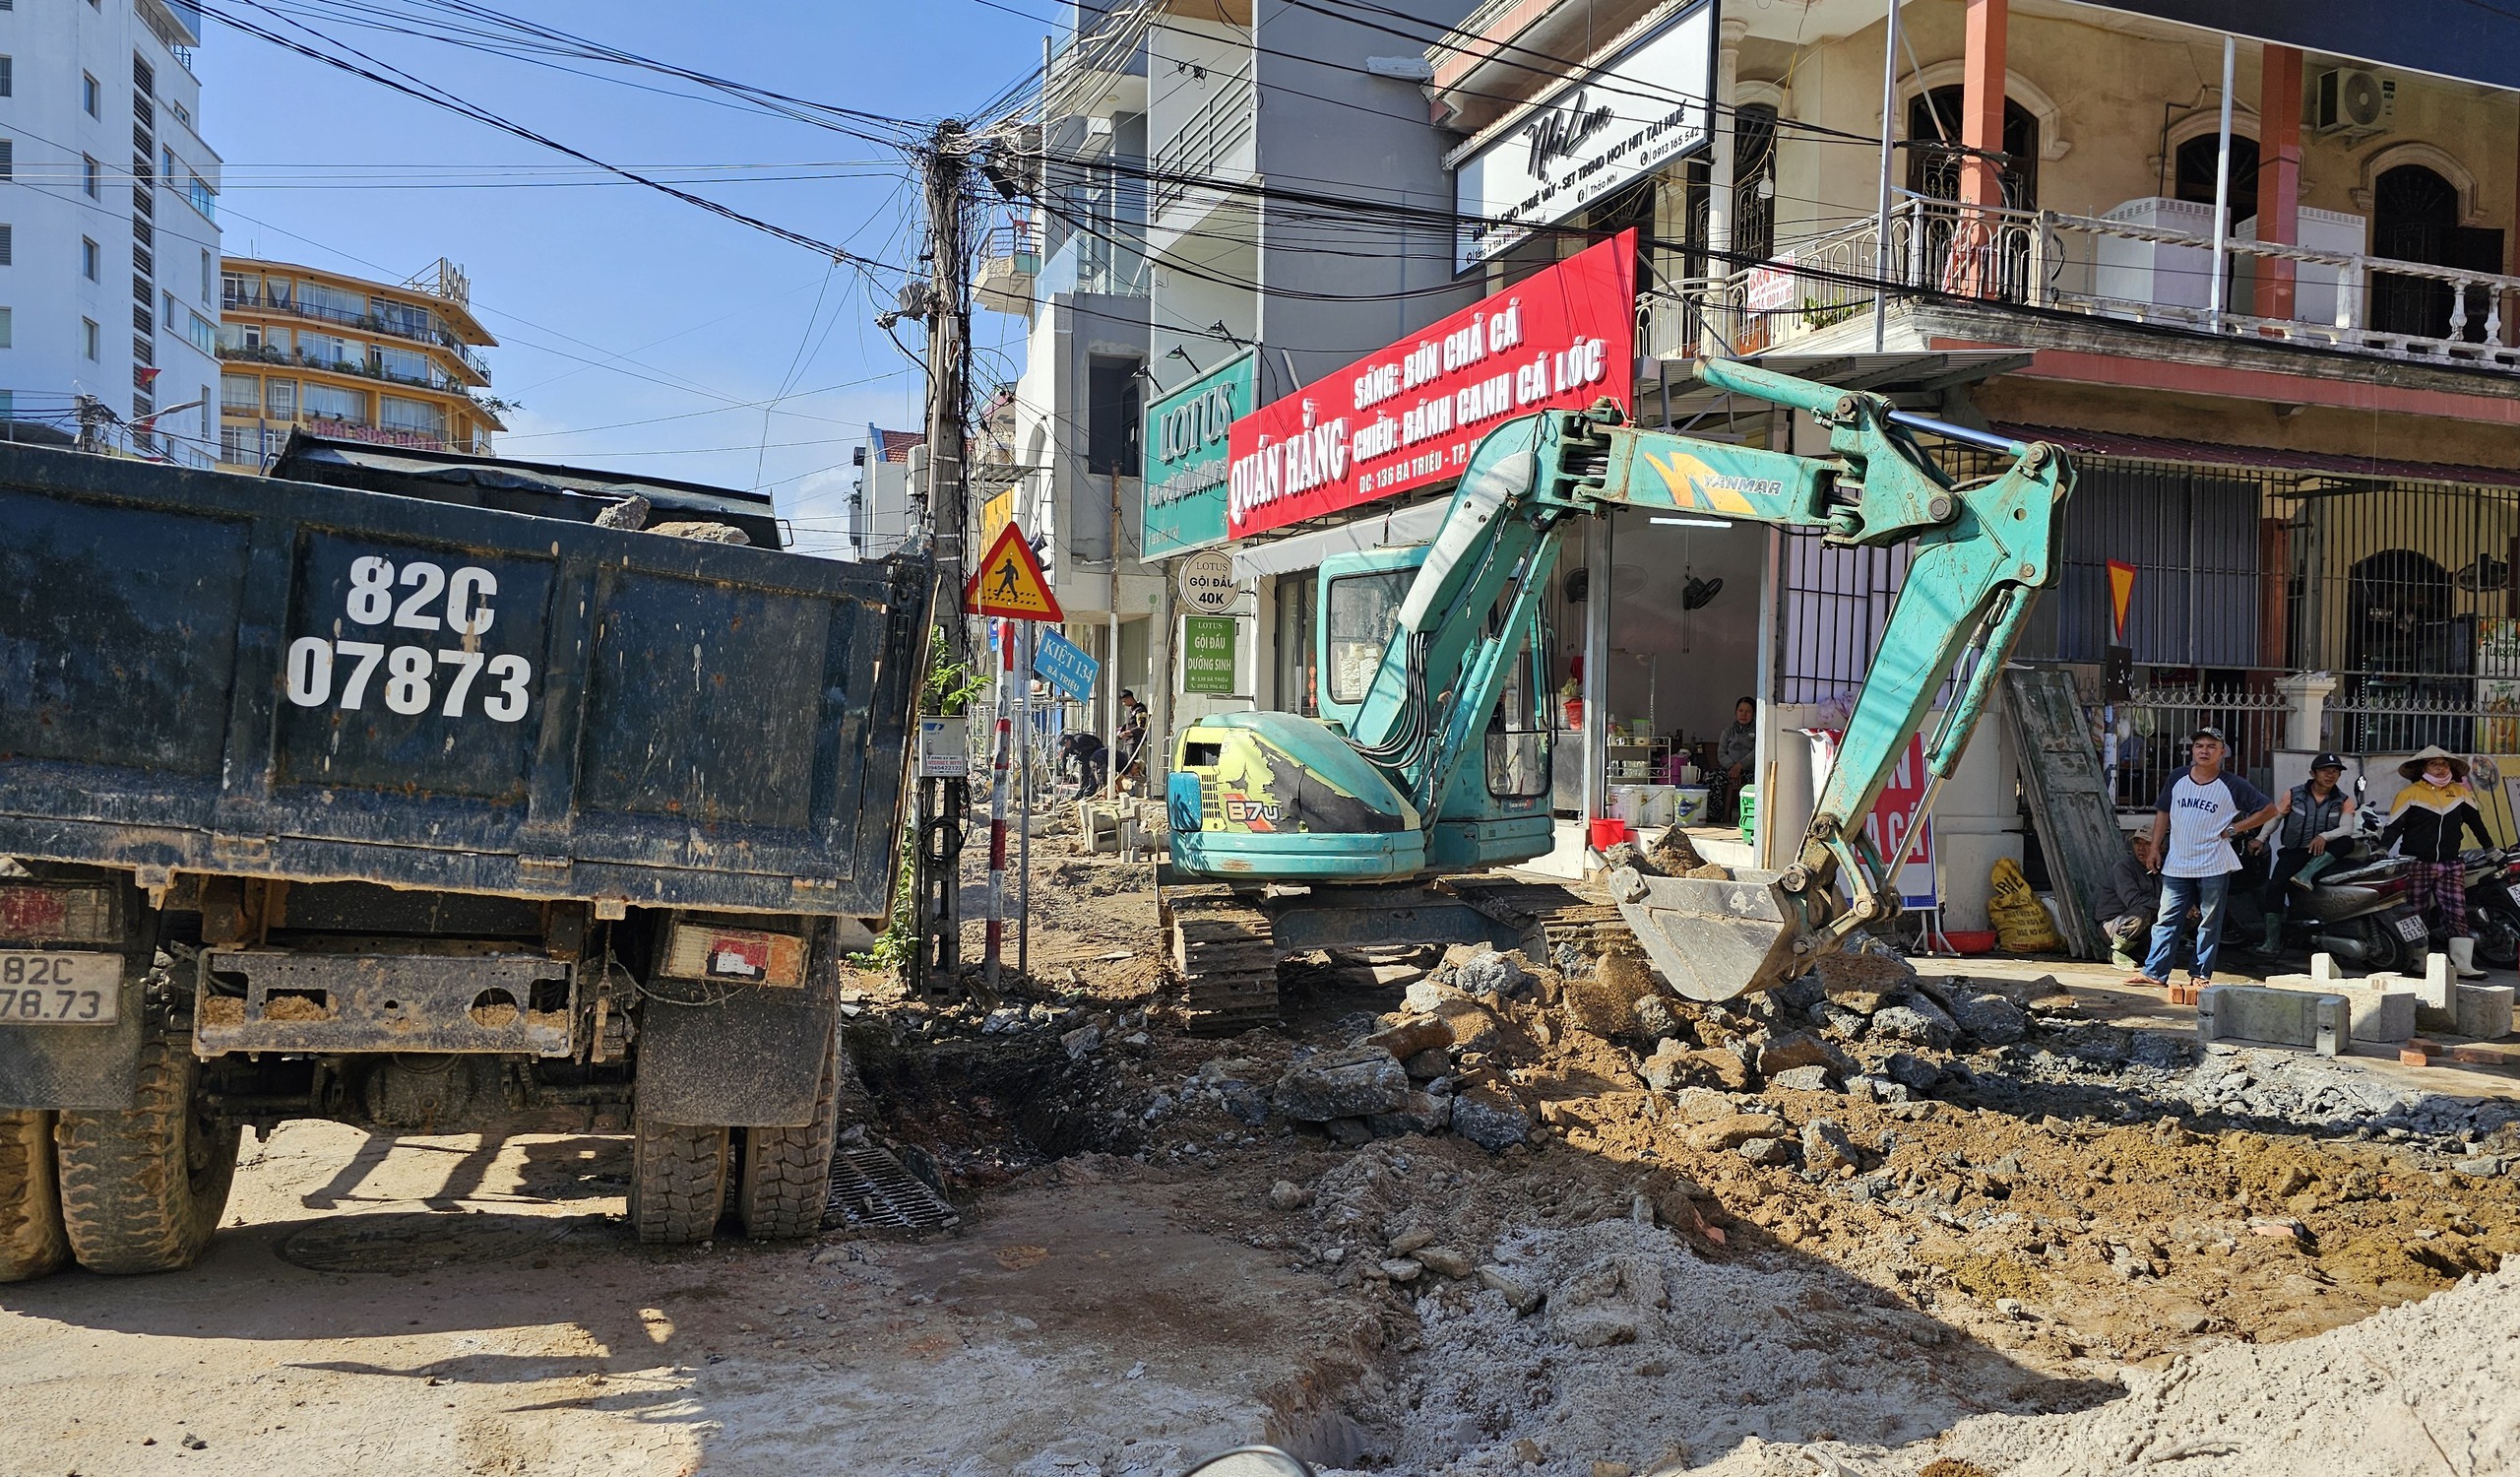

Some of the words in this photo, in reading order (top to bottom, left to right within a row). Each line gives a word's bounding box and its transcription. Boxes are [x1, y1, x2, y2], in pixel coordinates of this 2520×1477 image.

[1521, 190, 1540, 215] THUÊ
[1562, 171, 1576, 190] SET
[1578, 154, 1605, 181] TREND
[1607, 140, 1627, 164] HOT
[1629, 131, 1644, 154] HIT
[1646, 120, 1663, 143] TẠI
[1665, 98, 1687, 131] HUẾ
[1652, 143, 1669, 160] 0913
[1670, 135, 1682, 150] 165
[1685, 126, 1699, 142] 542
[1354, 364, 1400, 410] SÁNG:
[1404, 341, 1441, 389] BÚN
[1444, 313, 1485, 372] CHẢ
[1489, 297, 1521, 353] CÁ
[1354, 410, 1399, 463] CHIỀU:
[1403, 399, 1453, 445] BÁNH
[1457, 373, 1513, 425] CANH
[1517, 352, 1550, 405] CÁ
[1554, 336, 1605, 393] LÓC
[1160, 381, 1233, 463] LOTUS
[1230, 435, 1284, 525] QUÁN
[1285, 398, 1349, 495] HẰNG
[1376, 466, 1394, 488] 136
[1412, 449, 1442, 477] TRIỆU
[1452, 443, 1468, 466] TP.
[1703, 474, 1783, 495] YANMAR
[1189, 575, 1210, 590] GỘI
[1196, 561, 1228, 571] LOTUS
[346, 555, 497, 635] 82C
[1198, 592, 1225, 605] 40K
[1043, 637, 1076, 669] KIỆT
[1075, 661, 1094, 682] 134
[1194, 633, 1208, 652] GỘI
[286, 636, 532, 723] 07873
[1046, 665, 1058, 678] BÀ
[1059, 673, 1080, 692] TRIỆU
[1187, 655, 1214, 671] DƯỠNG
[1215, 658, 1231, 671] SINH
[4, 956, 74, 985] 82C
